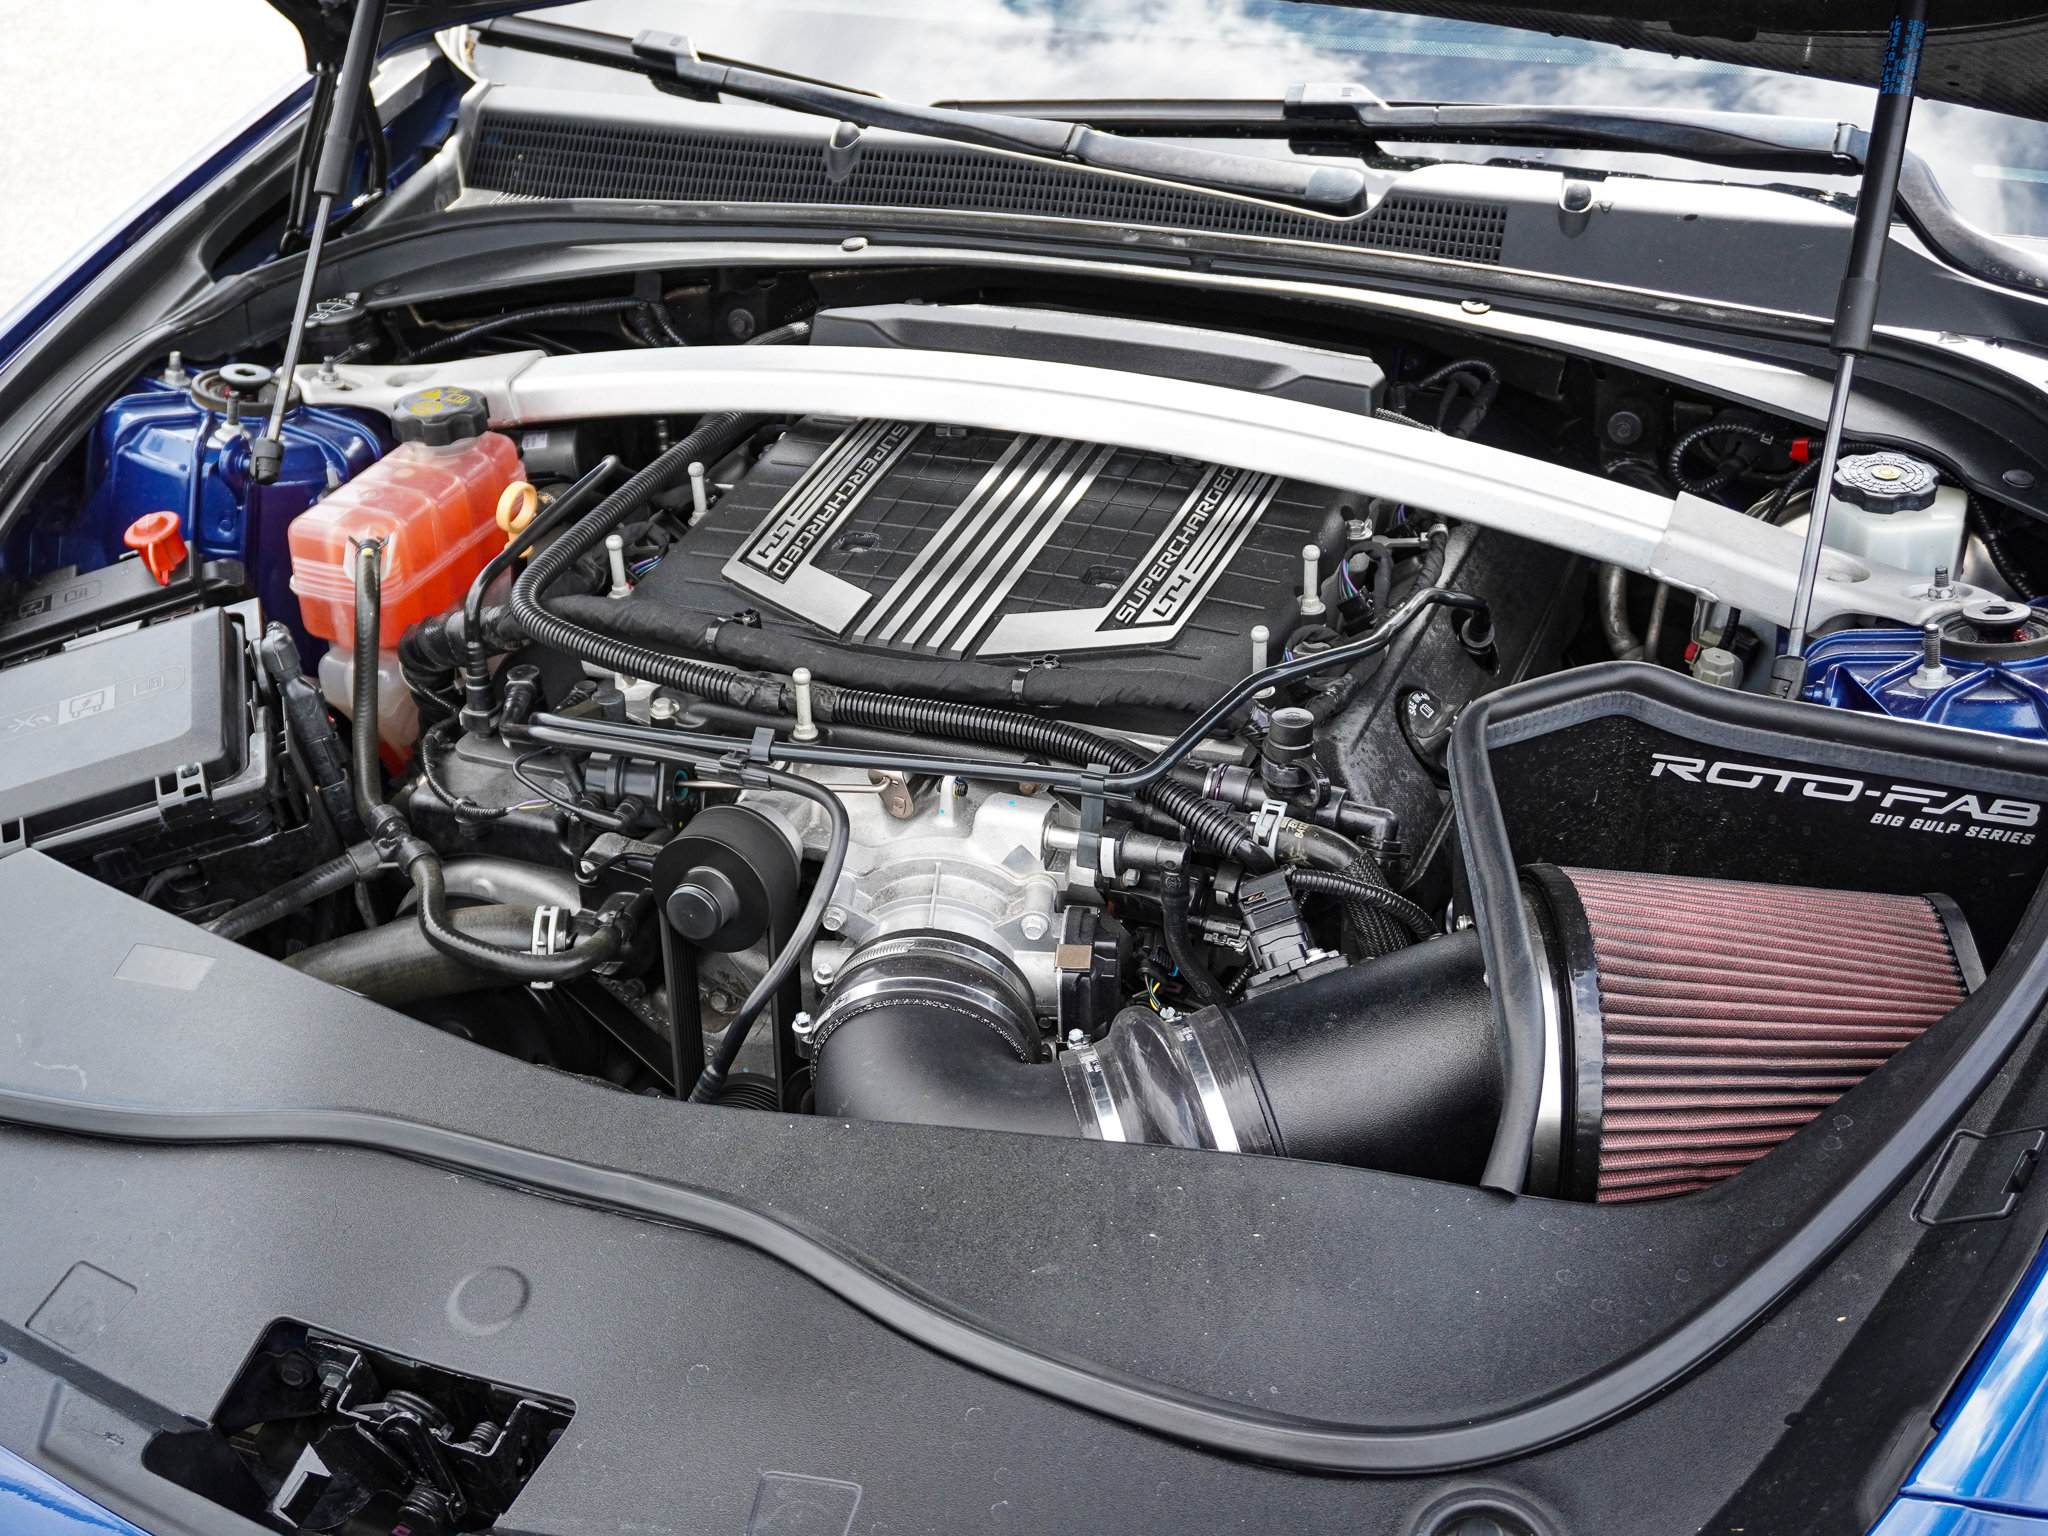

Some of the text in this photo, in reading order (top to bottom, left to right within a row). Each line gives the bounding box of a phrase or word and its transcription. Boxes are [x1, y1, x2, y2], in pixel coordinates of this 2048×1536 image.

[772, 424, 909, 578] SUPERCHARGED
[756, 517, 797, 560] LT4
[1152, 573, 1192, 618] LT4
[1650, 753, 2041, 827] ROTO-FAB
[1870, 812, 2036, 846] BIG GULP SERIES
